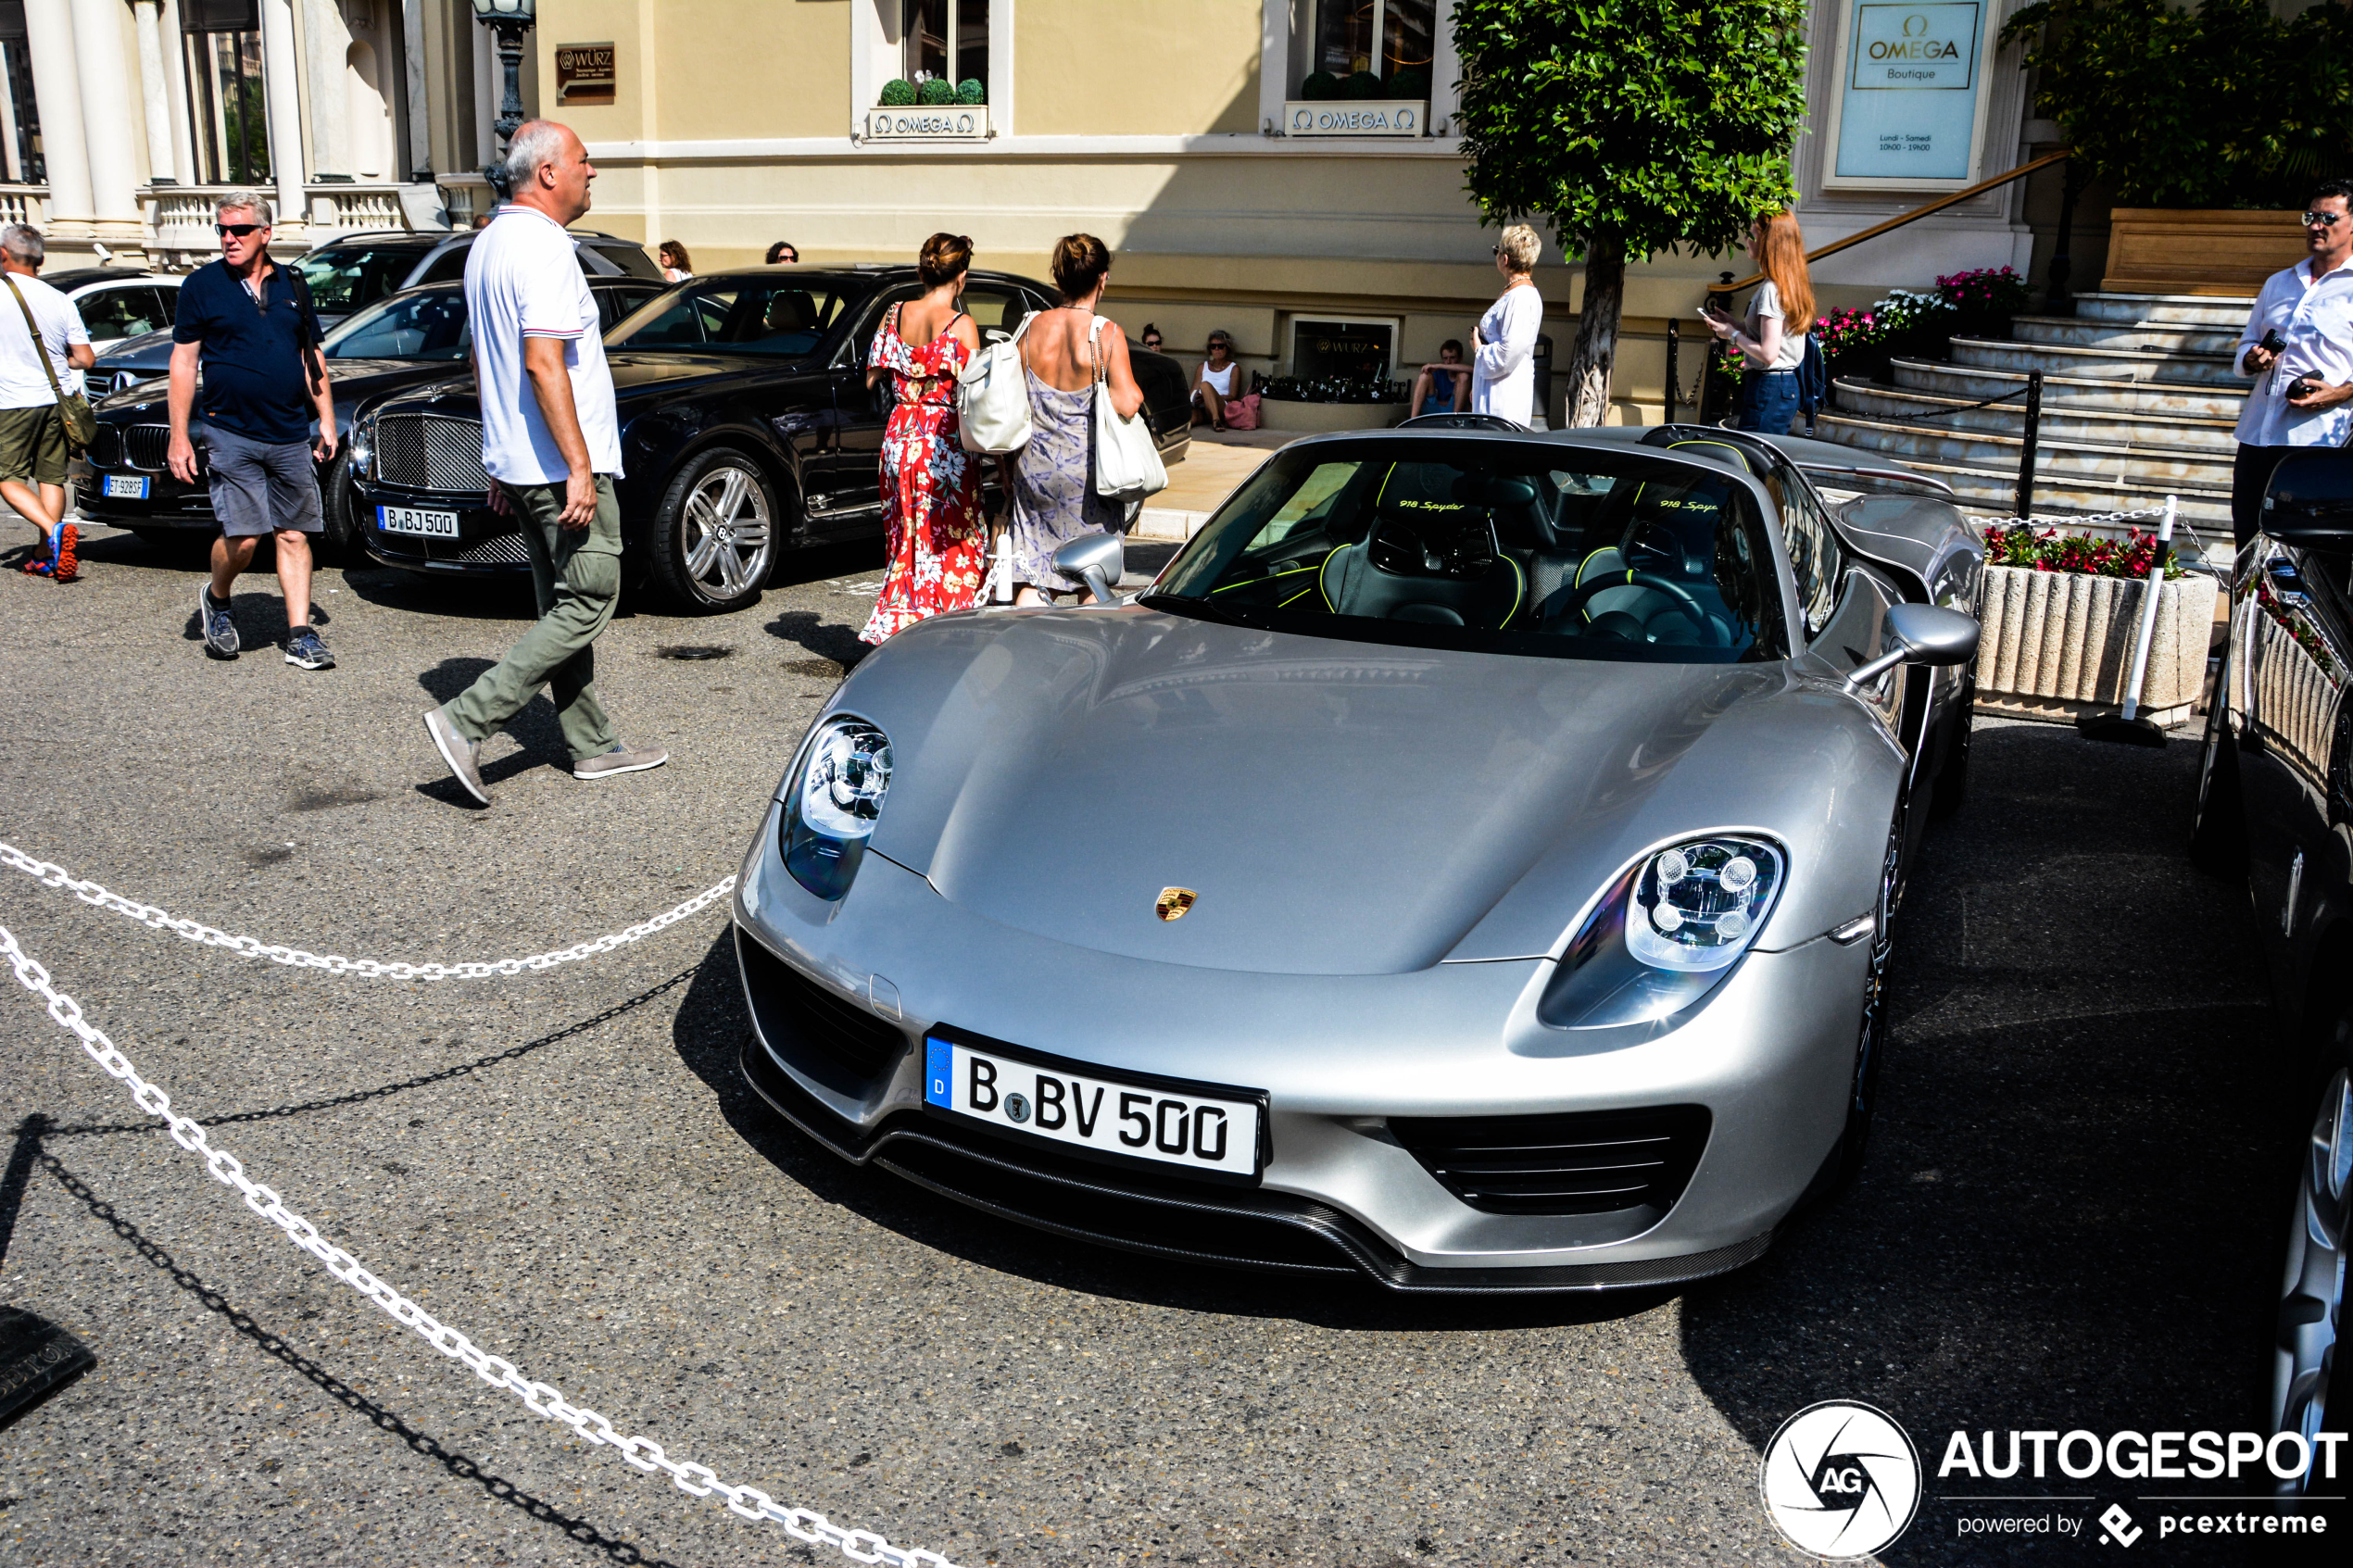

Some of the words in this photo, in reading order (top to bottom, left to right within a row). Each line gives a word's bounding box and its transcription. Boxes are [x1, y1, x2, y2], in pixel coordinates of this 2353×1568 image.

[575, 49, 611, 66] WÜRZ
[1869, 41, 1958, 59] OMEGA
[1887, 69, 1936, 82] Boutique
[896, 116, 953, 133] OMEGA
[1318, 111, 1388, 130] OMEGA
[1419, 501, 1465, 512] Spyder
[388, 508, 396, 528] B
[405, 510, 422, 532] BJ
[425, 513, 452, 534] 500
[934, 1079, 944, 1095] D
[970, 1056, 999, 1112] B
[1035, 1073, 1104, 1138] BV
[1119, 1091, 1228, 1161] 500
